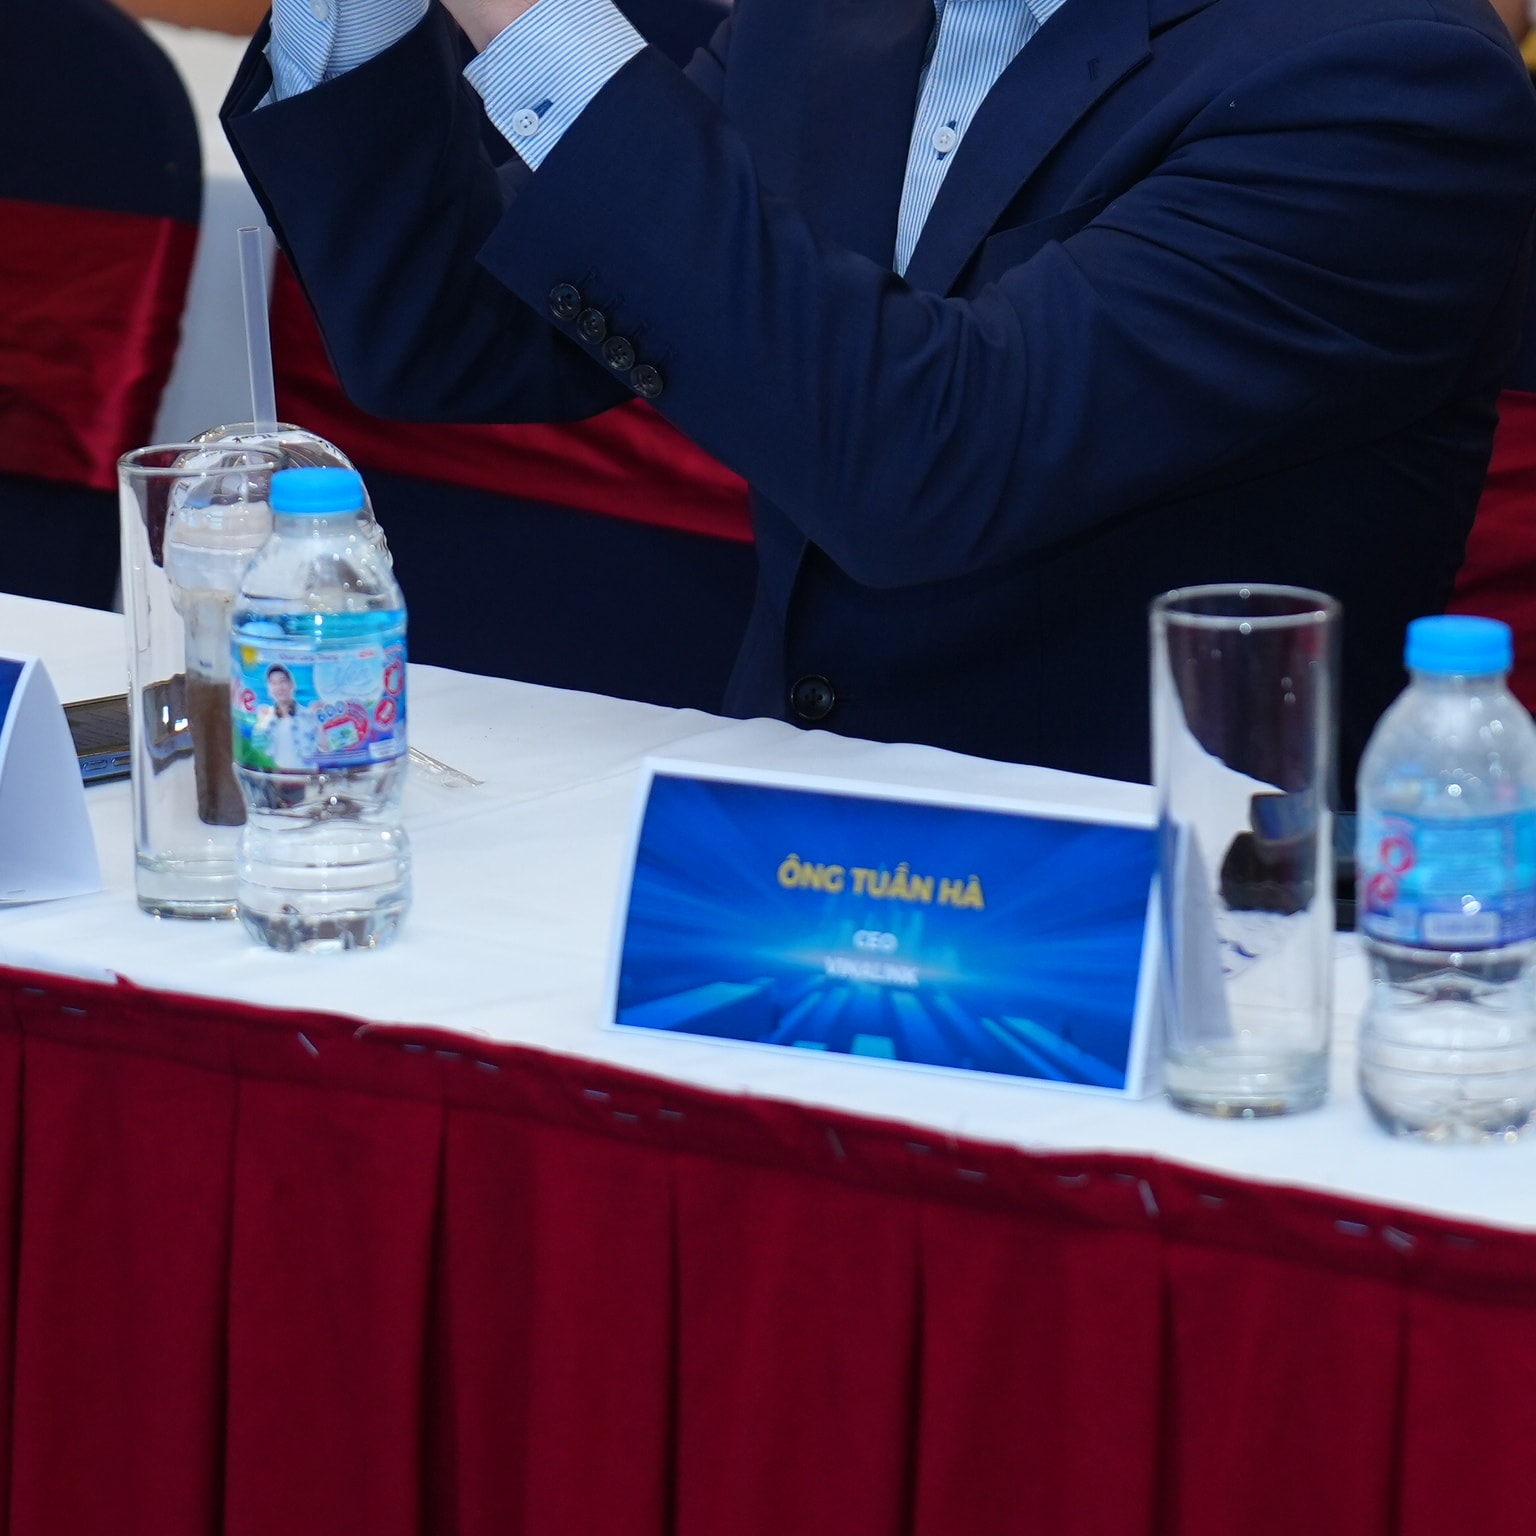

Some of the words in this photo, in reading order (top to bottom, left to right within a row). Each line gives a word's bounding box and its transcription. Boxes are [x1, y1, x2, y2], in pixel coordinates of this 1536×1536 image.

[777, 853, 846, 893] ÔNG
[938, 875, 985, 910] HÀ
[852, 929, 899, 955] CEO
